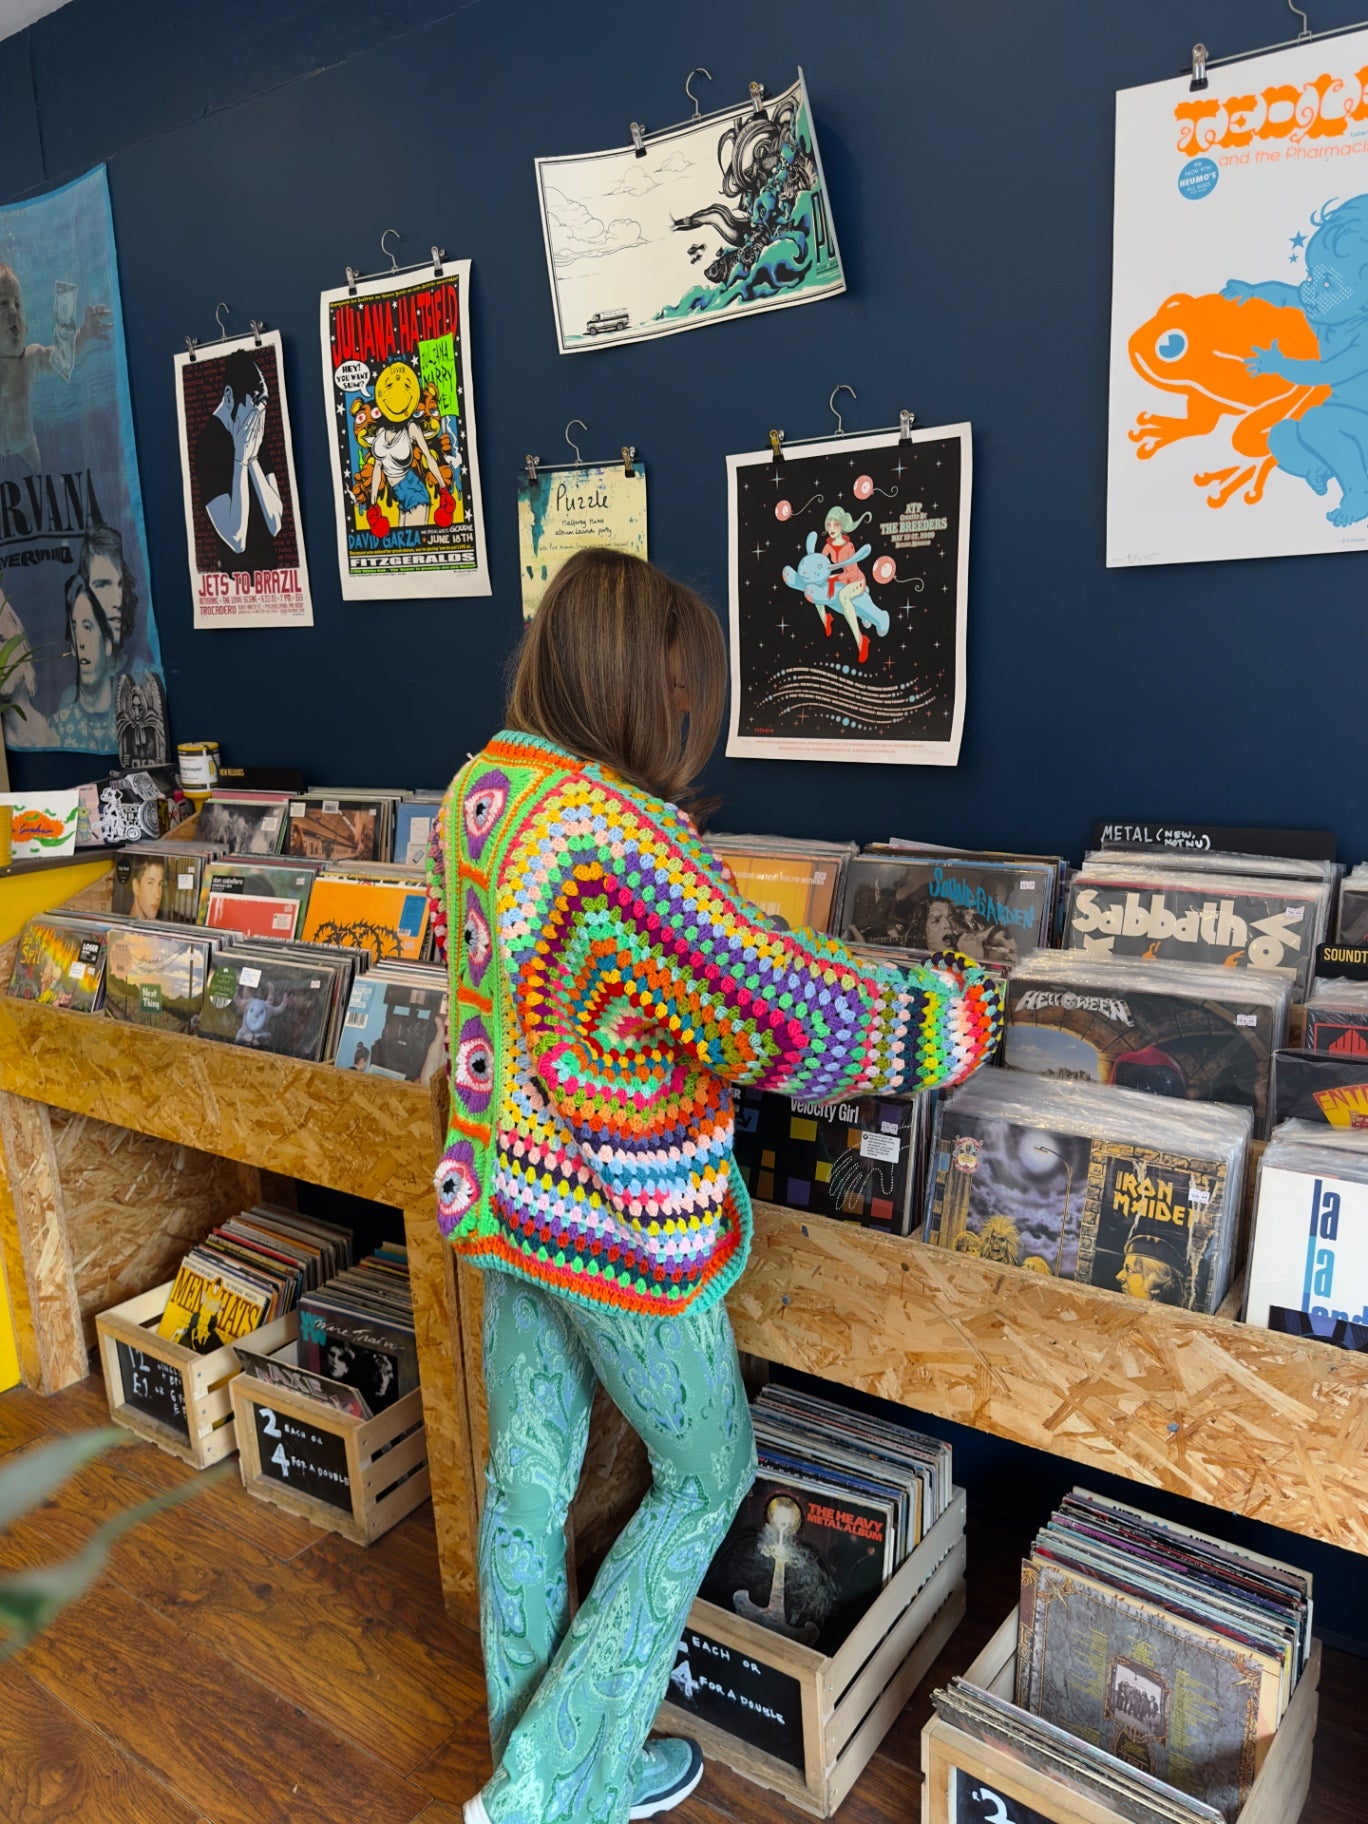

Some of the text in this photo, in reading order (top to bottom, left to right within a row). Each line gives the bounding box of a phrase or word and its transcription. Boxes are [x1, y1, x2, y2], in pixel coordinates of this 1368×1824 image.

[1219, 152, 1250, 167] and
[1255, 148, 1281, 163] the
[331, 303, 397, 369] JULIANA
[397, 285, 459, 355] HATFIELD
[0, 468, 107, 538] RVANA
[556, 483, 609, 512] Puzzle
[905, 502, 923, 514] ATP
[348, 533, 380, 550] DAVID
[382, 529, 421, 549] GARZA
[427, 533, 450, 545] JUNE
[555, 527, 574, 536] album
[598, 527, 612, 538] party
[880, 517, 948, 536] THE BREEDERS
[350, 553, 476, 567] FITZGERALDS
[198, 569, 302, 597] JETS TO BRAZIL
[199, 605, 237, 616] TROCADERO
[1101, 825, 1153, 843] METAL
[928, 866, 1036, 930] SOUNDGARDEN
[1072, 889, 1248, 947] Sabbath
[82, 943, 100, 953] LOSER
[142, 986, 158, 999] Next
[143, 997, 161, 1011] Thing
[790, 1098, 860, 1125] Velocity Girl
[1114, 1170, 1174, 1206] IRON
[171, 1267, 205, 1315] MEN
[216, 1289, 261, 1339] HATS
[314, 1318, 350, 1337] Wire
[351, 1328, 406, 1350] Train
[259, 1407, 282, 1438] 2
[284, 1423, 307, 1439] EACH
[271, 1442, 350, 1487] 4 FOR A DOUBLE
[806, 1513, 884, 1543] METAL ALBUM
[807, 1502, 884, 1532] THE HEAVY
[692, 1635, 762, 1675] EACH OR
[670, 1660, 786, 1725] 4 FOR A DOUBLE
